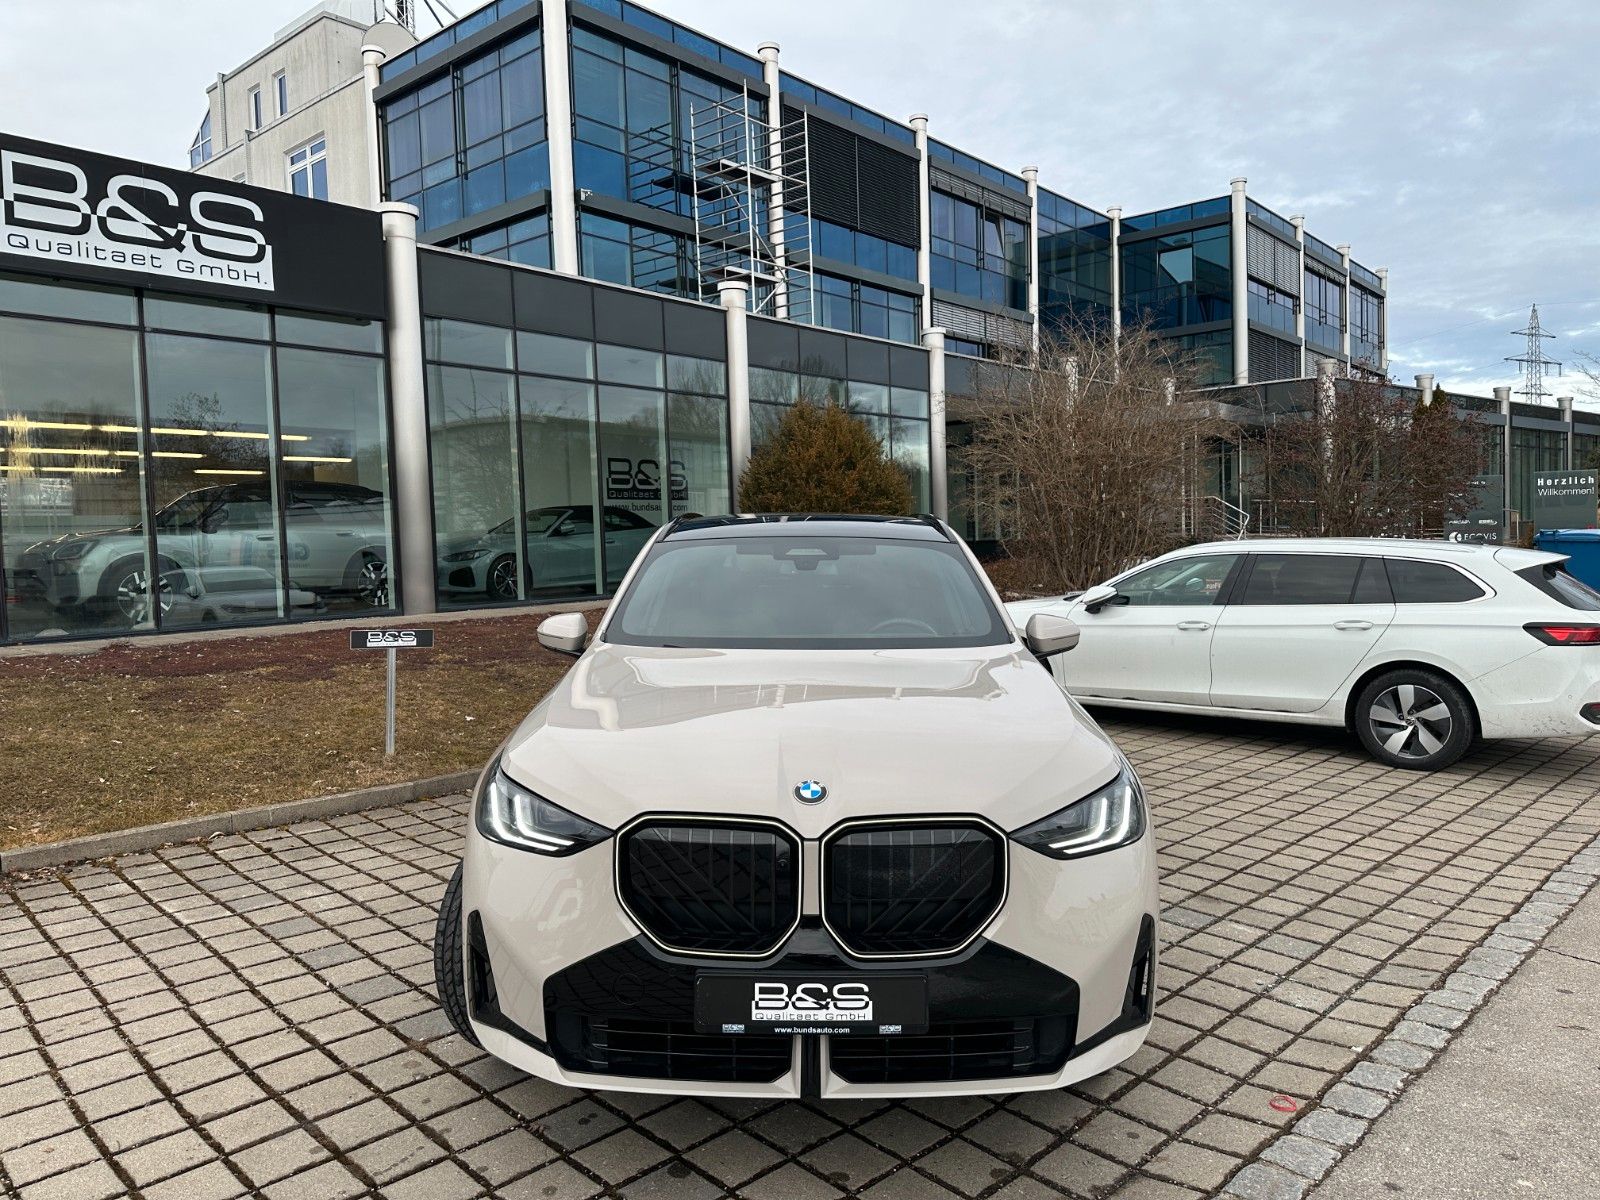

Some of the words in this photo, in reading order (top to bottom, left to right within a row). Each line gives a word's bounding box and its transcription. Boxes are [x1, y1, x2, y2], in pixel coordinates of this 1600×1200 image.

[2, 150, 267, 264] B&S
[8, 233, 162, 269] Qualitaet
[177, 260, 267, 284] GmbH.
[1537, 476, 1594, 486] Herzlich
[1537, 486, 1594, 496] Willkommen!
[368, 631, 415, 642] B&S
[755, 983, 870, 1010] B&S
[755, 1012, 819, 1020] Qualitaet
[774, 1026, 850, 1034] www.bundsauto.com
